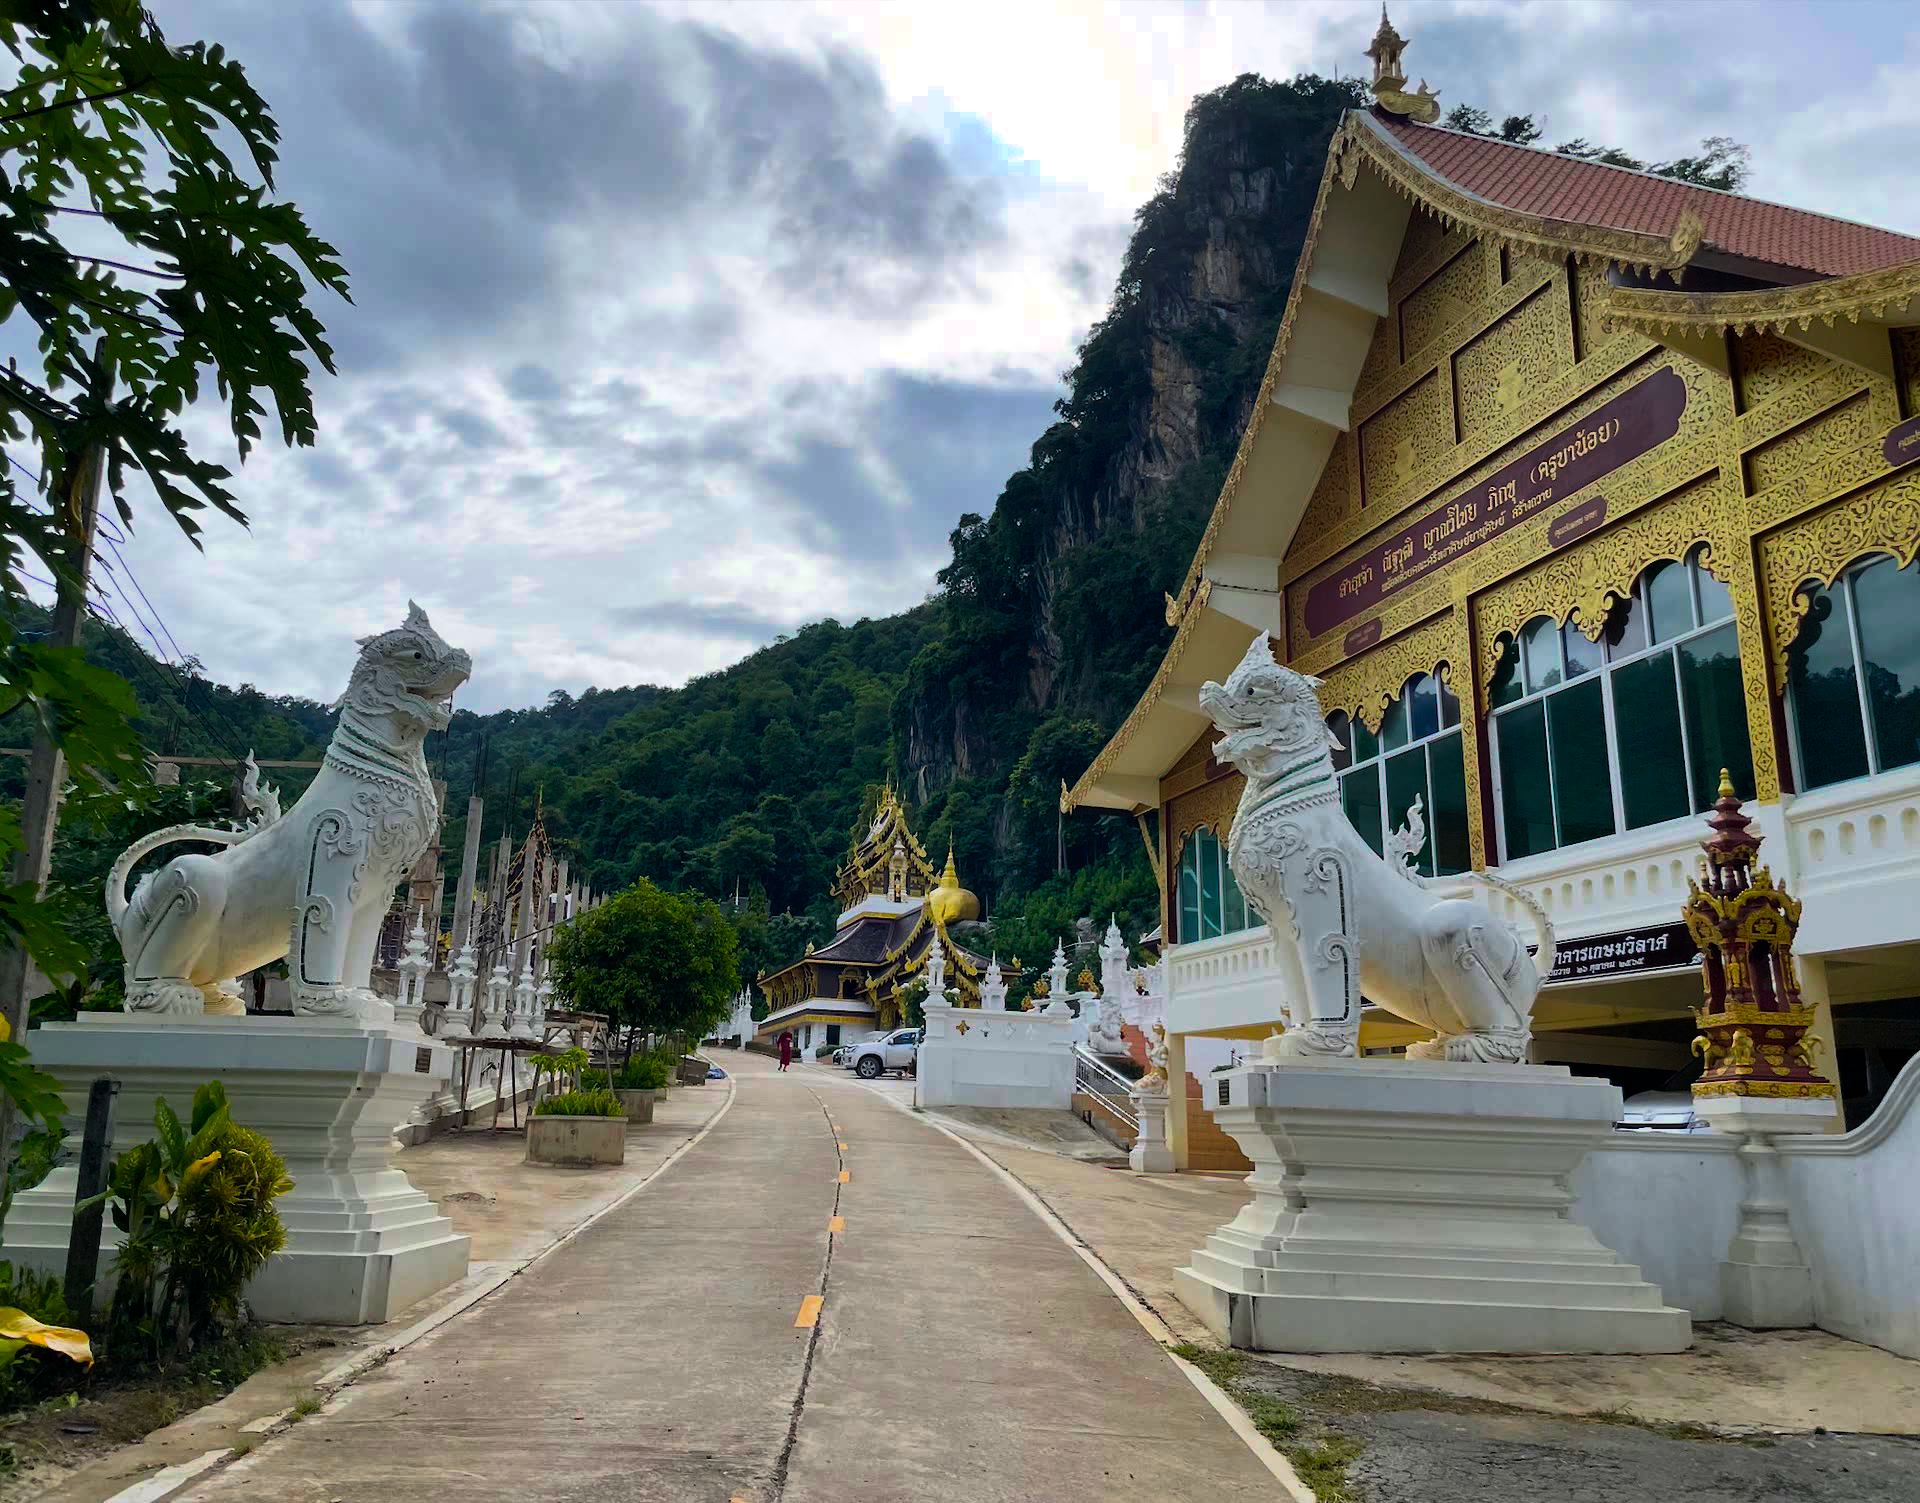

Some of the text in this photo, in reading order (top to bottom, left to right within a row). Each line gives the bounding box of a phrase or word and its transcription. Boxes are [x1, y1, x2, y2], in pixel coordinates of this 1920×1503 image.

[1487, 480, 1517, 511] ภิกขุ
[1530, 418, 1619, 484] (ครูบาน้อย)
[1511, 488, 1552, 519] สร้างถวาย
[1554, 933, 1669, 965] าคารเกษมวิลาศ
